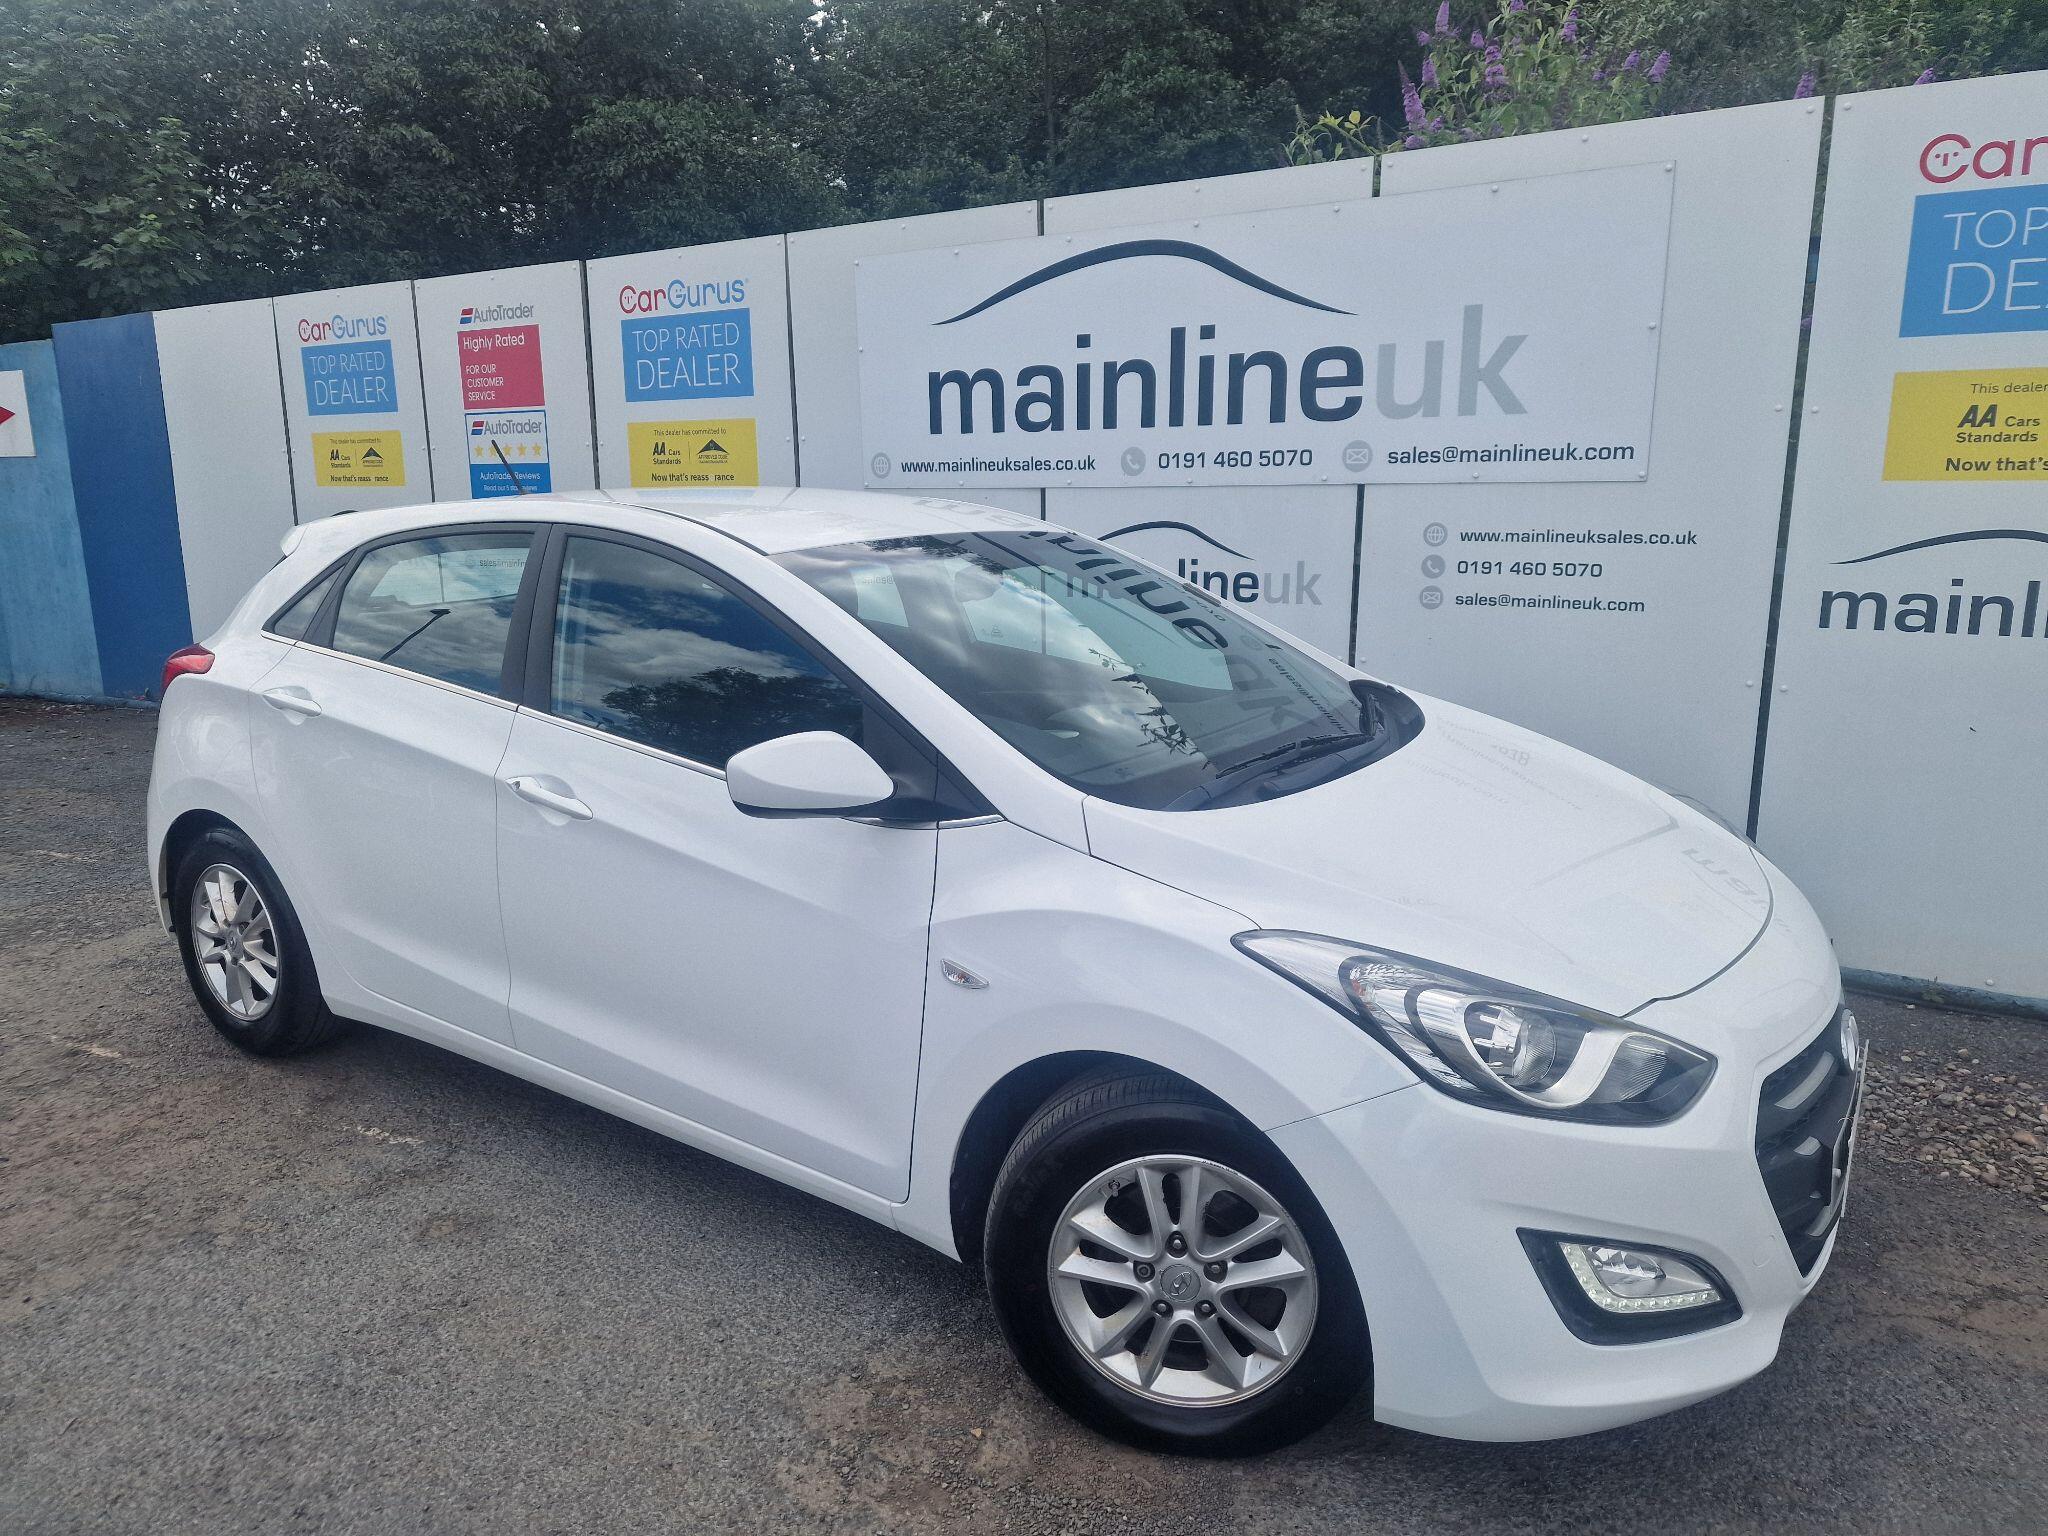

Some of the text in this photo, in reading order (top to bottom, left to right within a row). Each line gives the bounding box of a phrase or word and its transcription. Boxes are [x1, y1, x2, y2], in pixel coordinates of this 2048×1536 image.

[1944, 206, 2048, 250] TOP
[619, 278, 745, 314] CarGurus
[1942, 257, 2048, 315] DE
[473, 302, 534, 323] AutoTrader
[298, 314, 387, 342] CarGurus
[632, 322, 740, 353] TOP RATED
[463, 332, 525, 353] Highly Rated
[309, 351, 385, 375] TOP RATED
[466, 363, 497, 375] FOR OUR
[636, 352, 741, 389] DEALER
[928, 304, 1530, 435] mainlineuk
[314, 376, 390, 406] DEALER
[467, 376, 504, 388] CUSTOMER
[1970, 382, 1999, 394] This
[468, 390, 496, 401] SERVICE
[1957, 404, 2040, 428] AA Cars
[484, 419, 542, 436] AutoTrader
[1956, 430, 2039, 443] Standards
[330, 449, 340, 461] AA
[653, 442, 681, 456] AA Cars
[1158, 448, 1314, 470] 0191 460 5070
[1387, 442, 1635, 464] sales@mainlineuk.com
[652, 457, 682, 465] Standards
[900, 455, 1096, 473] www.mainlineuksales.co.uk
[1945, 457, 1991, 471] Now
[480, 472, 512, 480] AutoTrade
[651, 473, 668, 482] Now
[669, 473, 689, 481] that's
[1460, 529, 1698, 546] www.mainlineuksales.co.uk
[1457, 560, 1603, 578] 0191 460 5070
[1455, 592, 1645, 612] sales@mainlineuk.com
[1818, 578, 2048, 638] mainl
